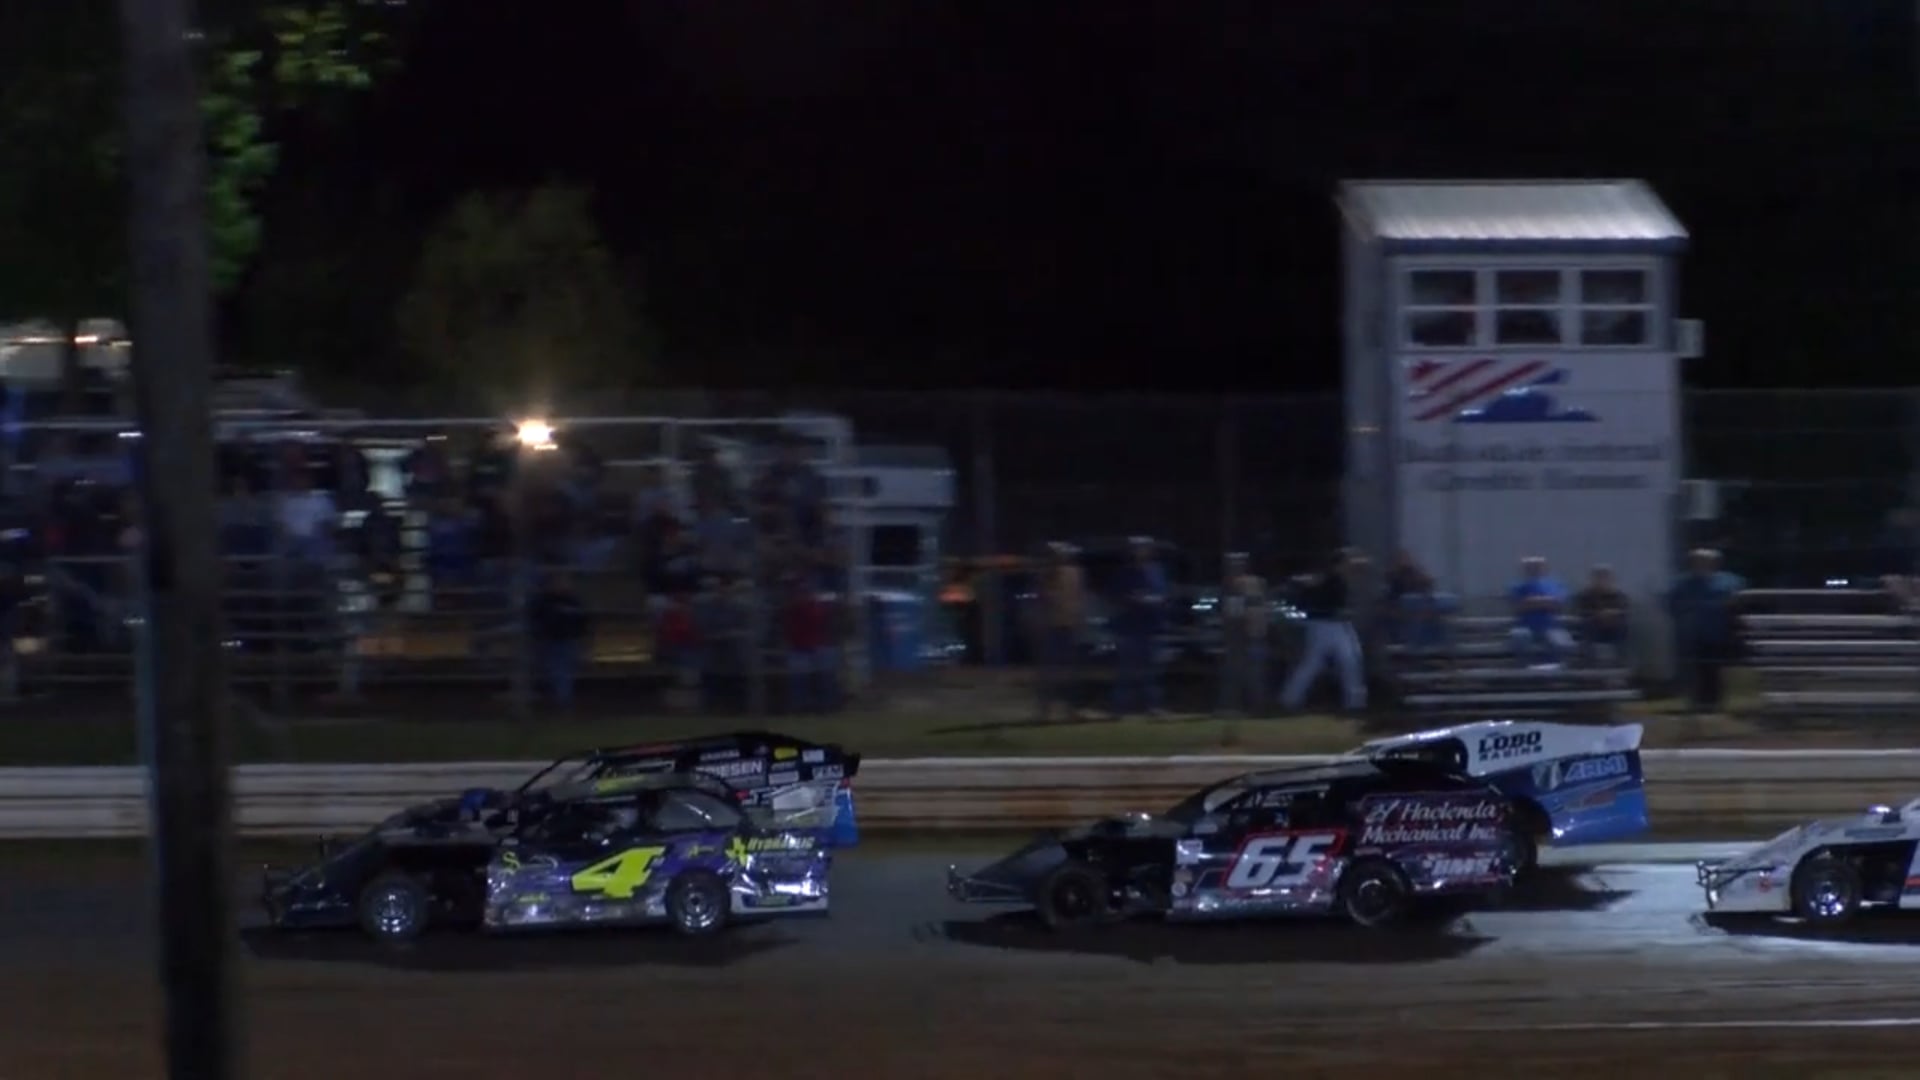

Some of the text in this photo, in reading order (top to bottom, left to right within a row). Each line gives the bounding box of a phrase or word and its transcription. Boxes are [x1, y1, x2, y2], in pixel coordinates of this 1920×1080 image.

[1479, 730, 1541, 752] LOBO
[1401, 799, 1496, 821] Hacienda
[1361, 821, 1467, 844] Mechanical
[571, 845, 667, 898] 4
[1227, 834, 1336, 887] 65
